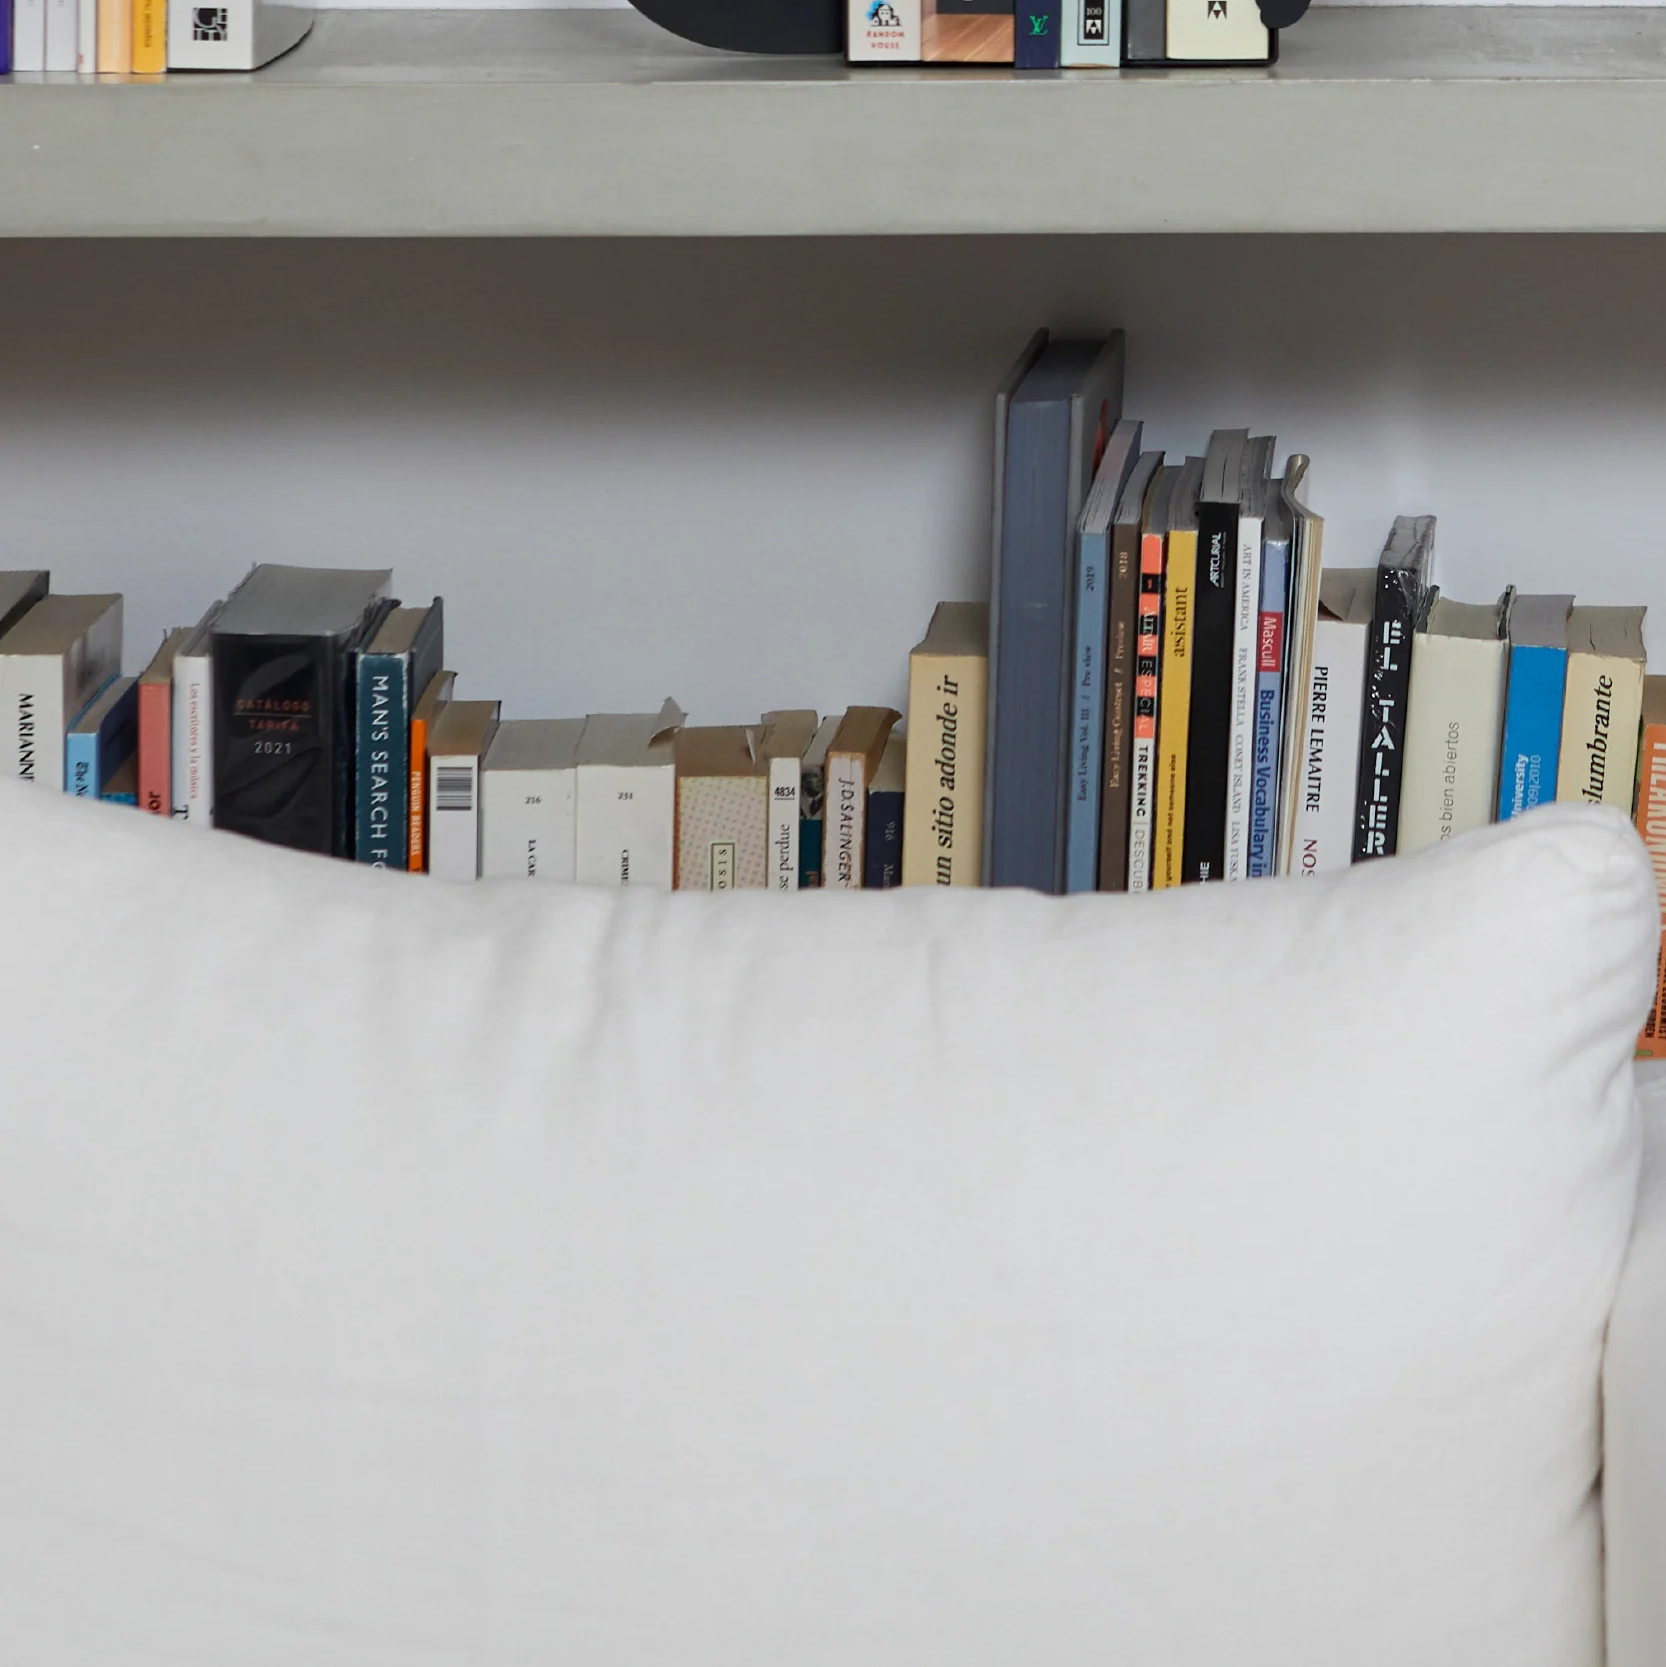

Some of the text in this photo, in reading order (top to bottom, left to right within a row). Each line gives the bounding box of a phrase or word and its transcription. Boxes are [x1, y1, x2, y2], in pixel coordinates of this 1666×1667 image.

[371, 676, 389, 838] MAN'S SEARCH
[1251, 617, 1277, 876] Mascull Business Vocabulary in
[1306, 666, 1328, 812] PIERRE LEMAITRE
